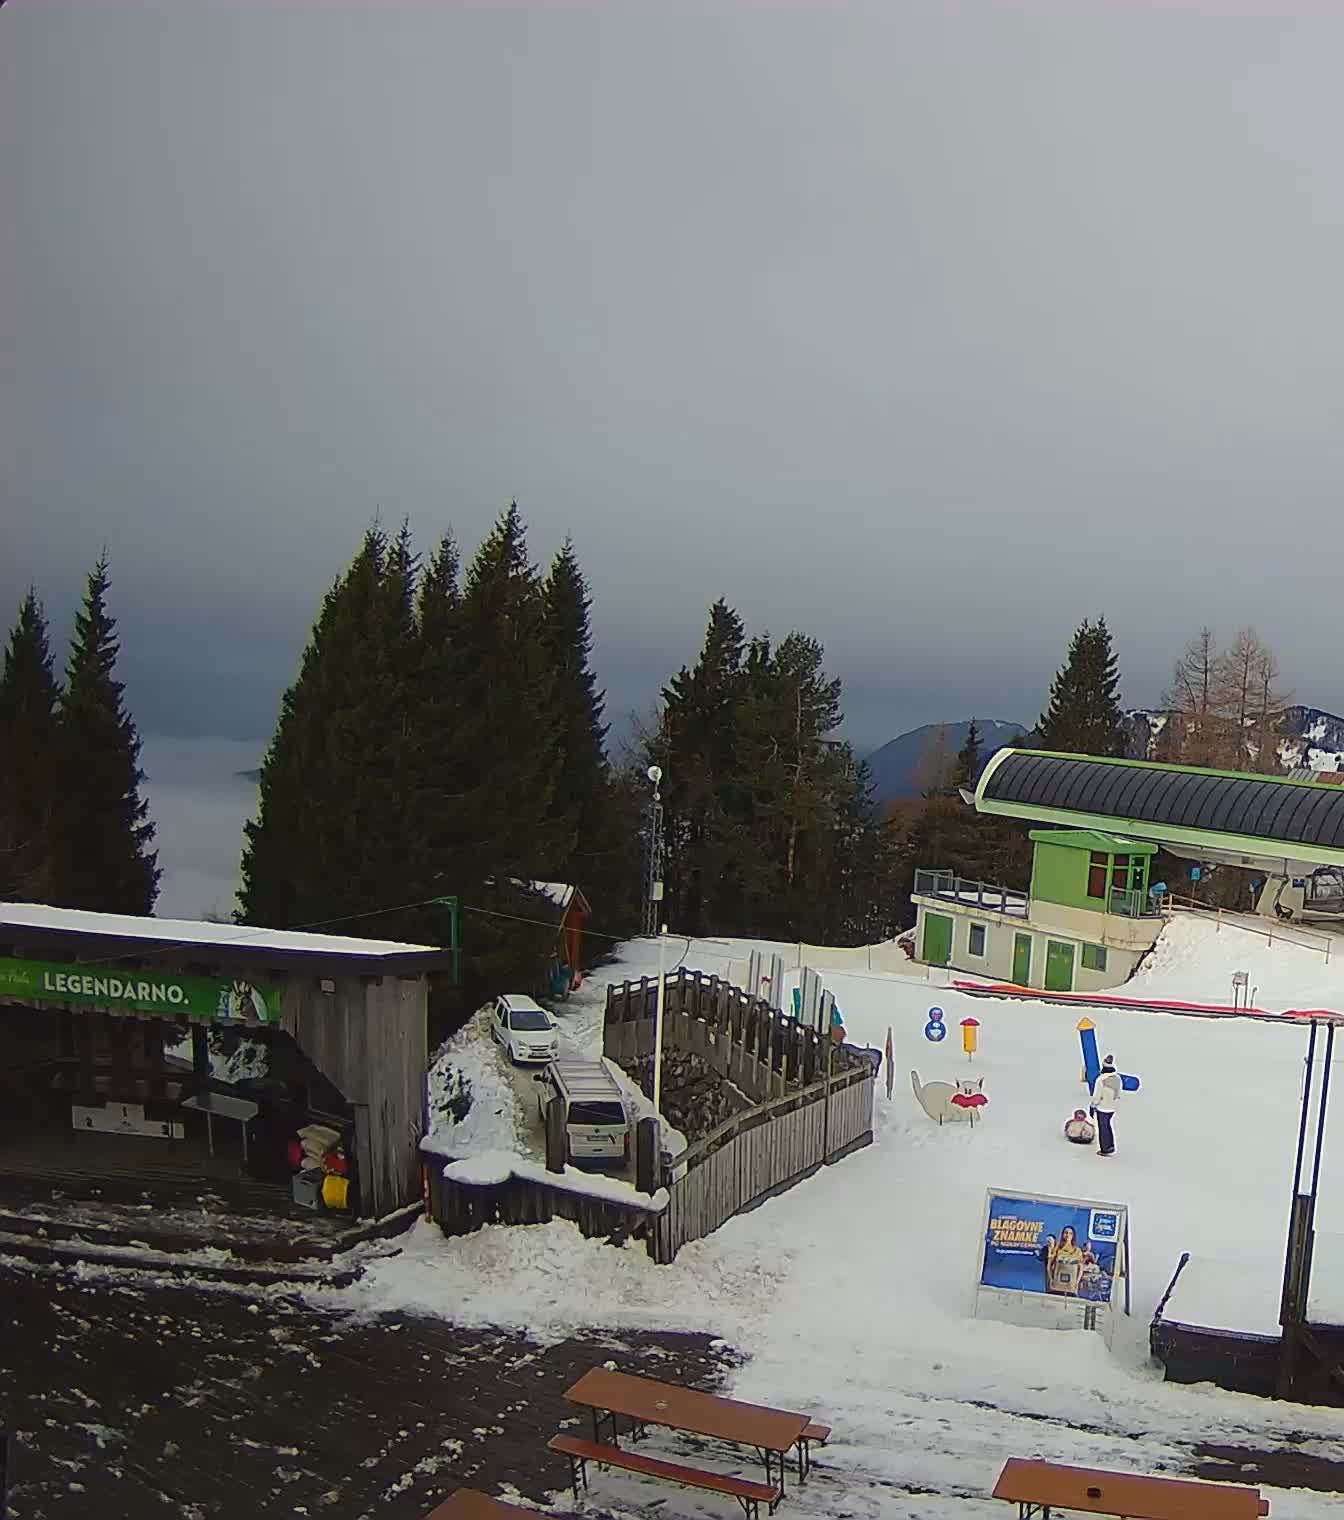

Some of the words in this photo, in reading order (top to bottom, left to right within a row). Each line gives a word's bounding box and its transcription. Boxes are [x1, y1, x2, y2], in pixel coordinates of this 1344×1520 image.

[43, 972, 189, 1005] LEGENDARNO.
[991, 1219, 1044, 1232] BLAGOVNE
[993, 1230, 1039, 1243] ZNAMKE
